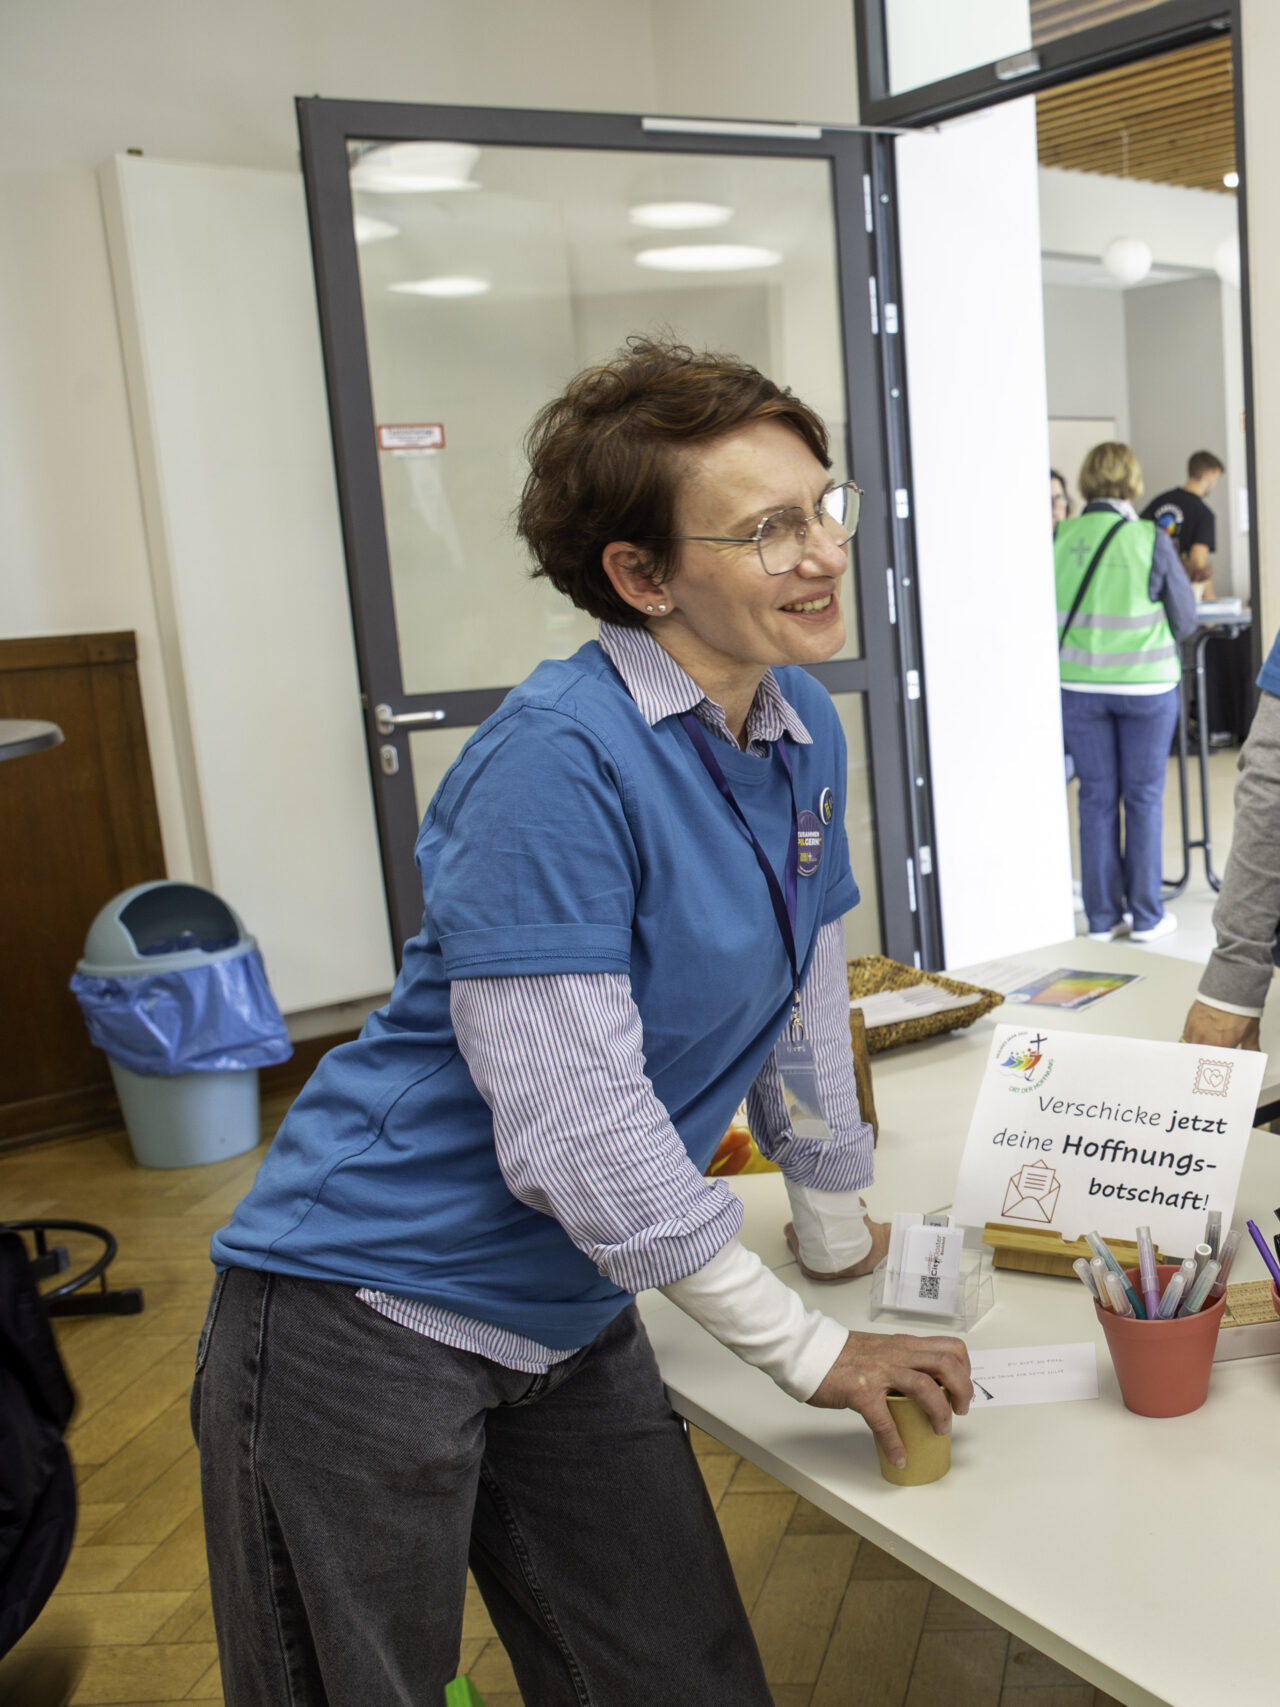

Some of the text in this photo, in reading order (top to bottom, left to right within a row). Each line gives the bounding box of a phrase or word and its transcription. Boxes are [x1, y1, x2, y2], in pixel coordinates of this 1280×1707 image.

[1038, 1095, 1228, 1134] Verschicke jetzt
[992, 1128, 1217, 1176] deine Hoffnungs-
[1088, 1177, 1210, 1211] botschaft!
